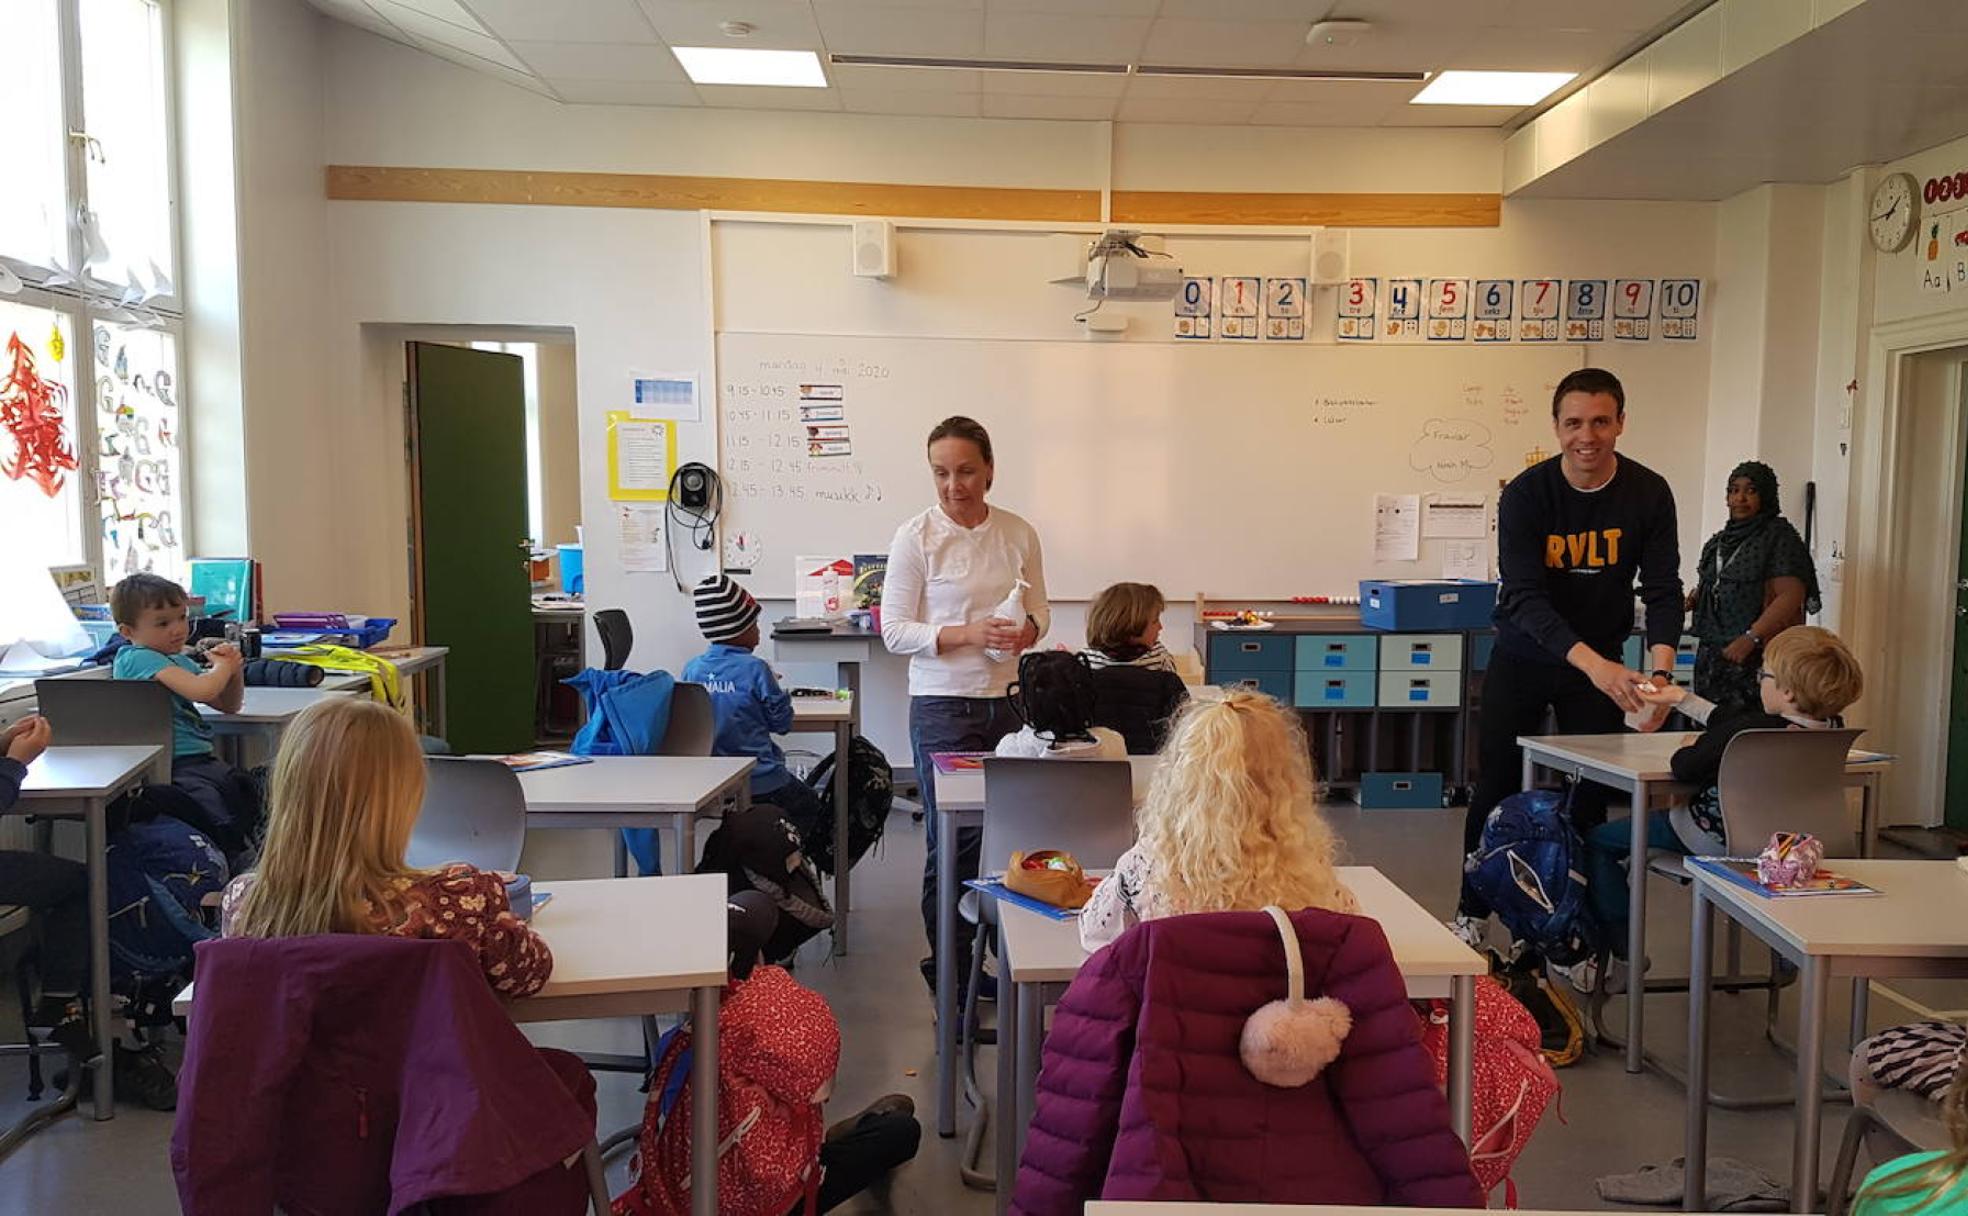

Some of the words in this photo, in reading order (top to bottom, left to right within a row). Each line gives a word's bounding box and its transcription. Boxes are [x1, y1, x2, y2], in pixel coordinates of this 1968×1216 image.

[1942, 182, 1949, 197] 2
[1185, 281, 1200, 304] 0
[1235, 281, 1244, 304] 1
[1278, 282, 1293, 305] 2
[1349, 282, 1364, 305] 3
[1393, 287, 1408, 308] 4
[1441, 282, 1456, 305] 5
[1487, 284, 1500, 306] 6
[1535, 282, 1550, 304] 7
[1578, 283, 1593, 306] 8
[1626, 283, 1641, 306] 9
[1665, 283, 1694, 306] 10
[858, 364, 890, 379] 2020
[815, 485, 860, 503] musikk
[1545, 528, 1622, 568] RVLT
